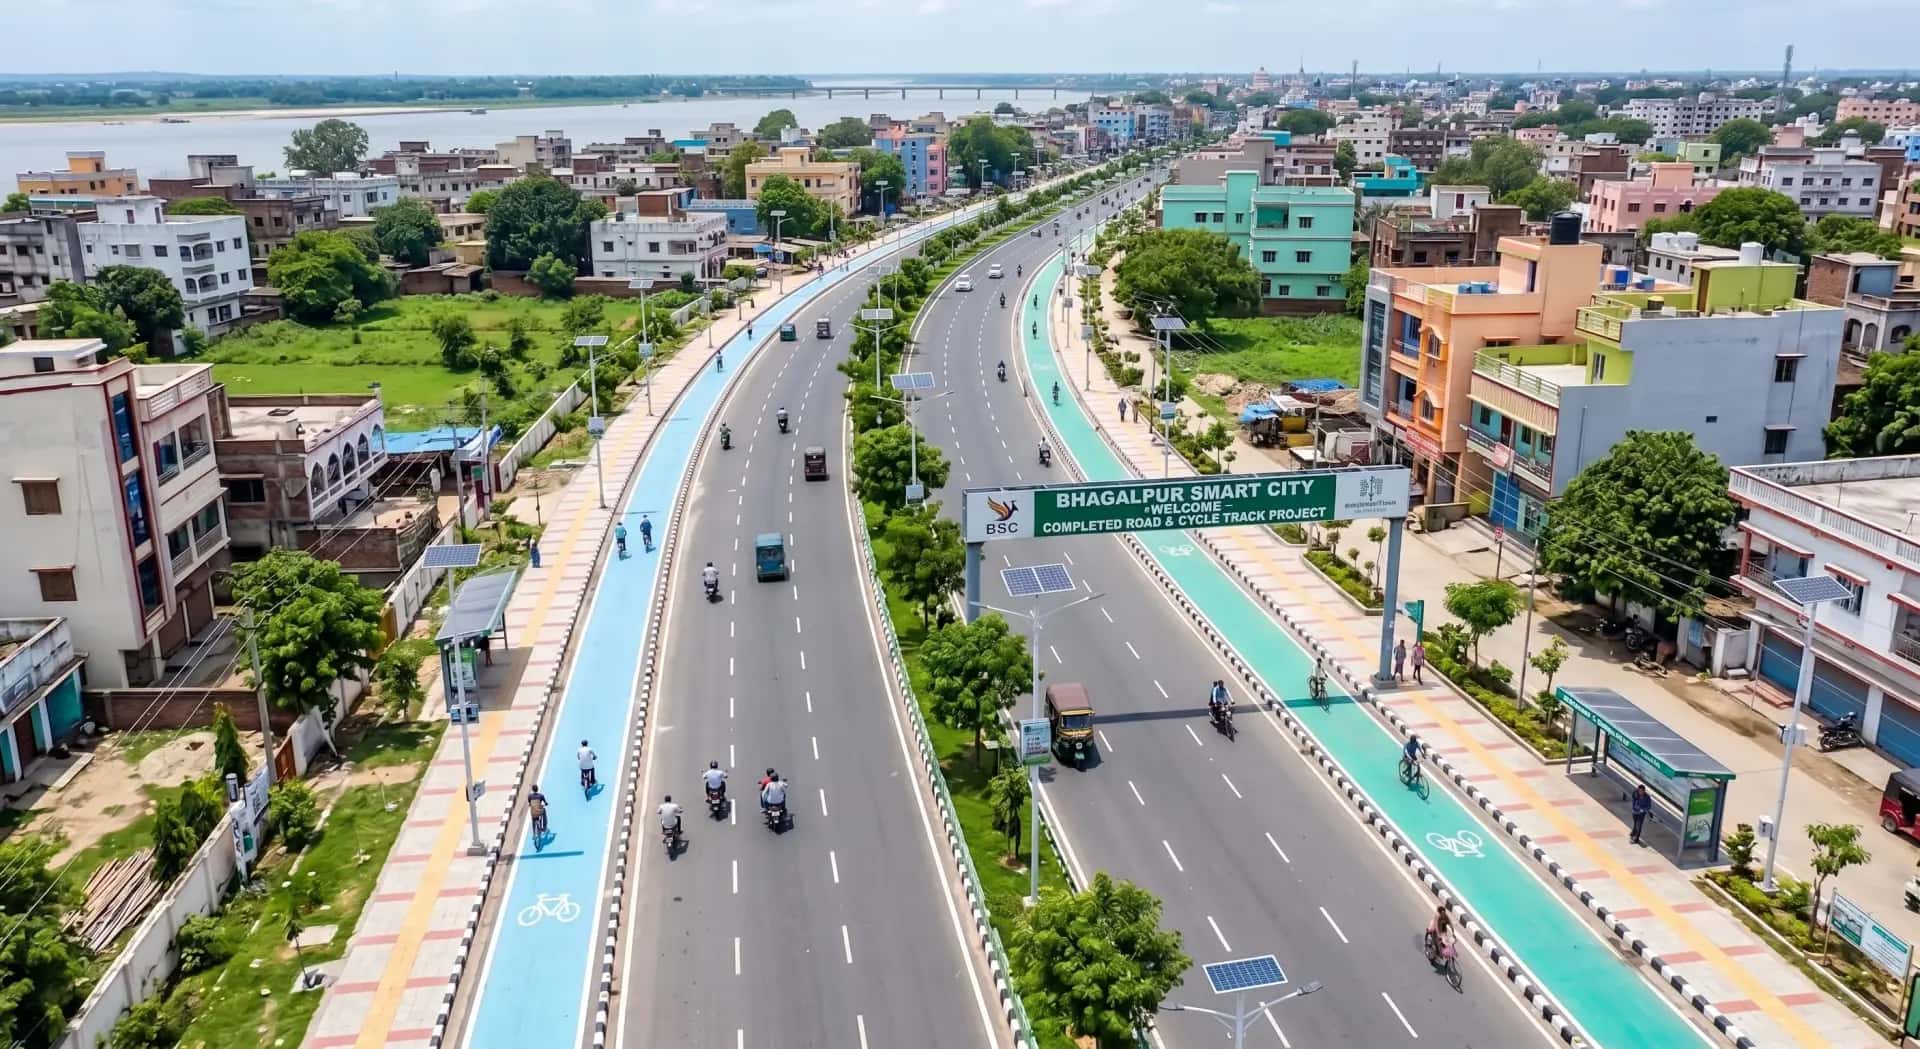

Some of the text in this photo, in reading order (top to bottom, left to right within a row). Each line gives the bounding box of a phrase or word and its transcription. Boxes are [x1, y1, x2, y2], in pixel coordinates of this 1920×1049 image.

[1056, 479, 1315, 508] BHAGALPUR SMART CITY
[986, 522, 1018, 535] BSC
[1043, 506, 1327, 533] COMPLETED ROAD & CYCLE TRACK PROJECT
